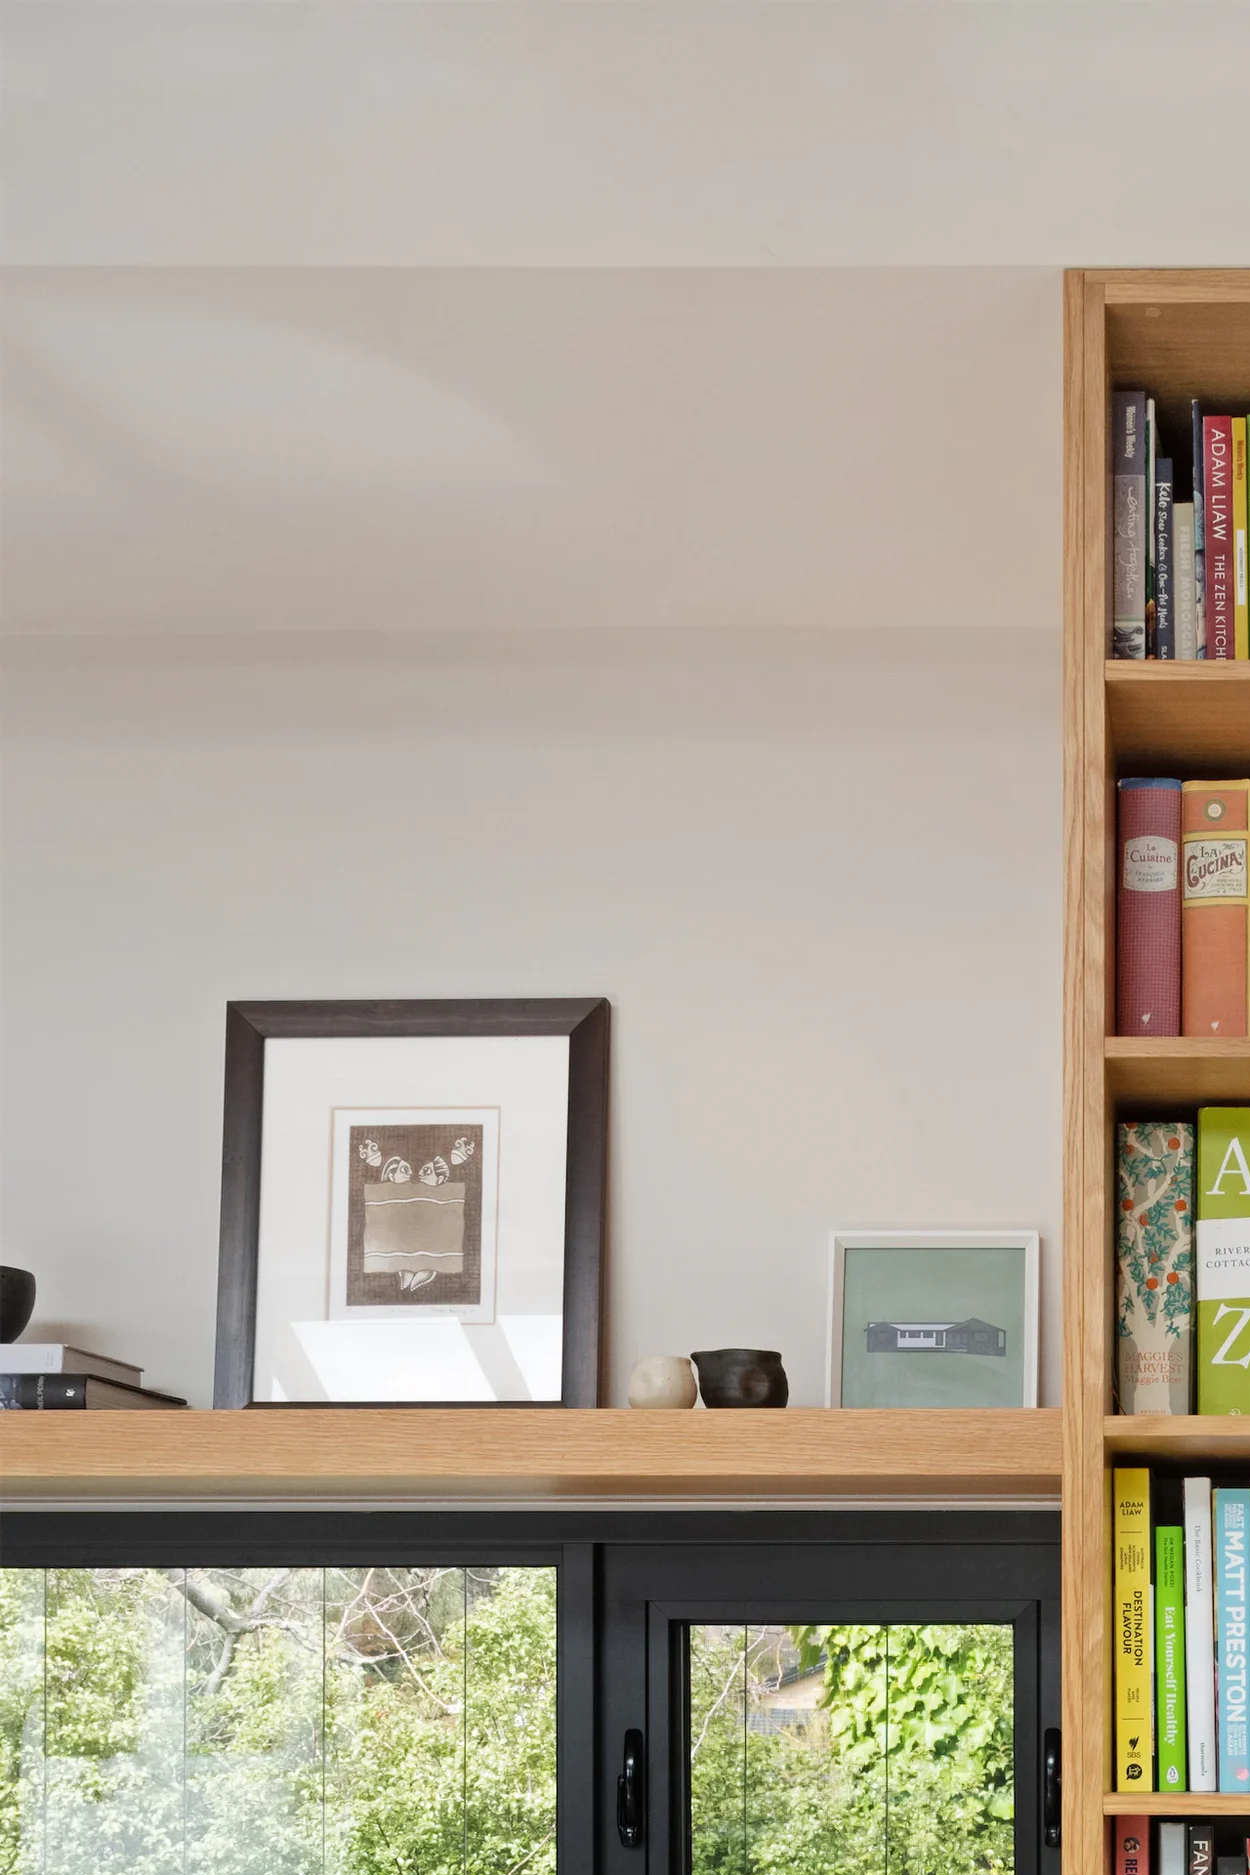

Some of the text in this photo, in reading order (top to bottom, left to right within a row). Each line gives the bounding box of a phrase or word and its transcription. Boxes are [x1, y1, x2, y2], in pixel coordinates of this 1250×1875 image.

[1212, 429, 1226, 611] ADAM LIAW THE ZEN
[1215, 1246, 1250, 1256] RIVER
[1225, 1532, 1244, 1601] MATT
[1123, 1602, 1131, 1654] FLAVOUR
[1133, 1591, 1143, 1666] DESTINATION
[1226, 1607, 1246, 1721] PRESTON
